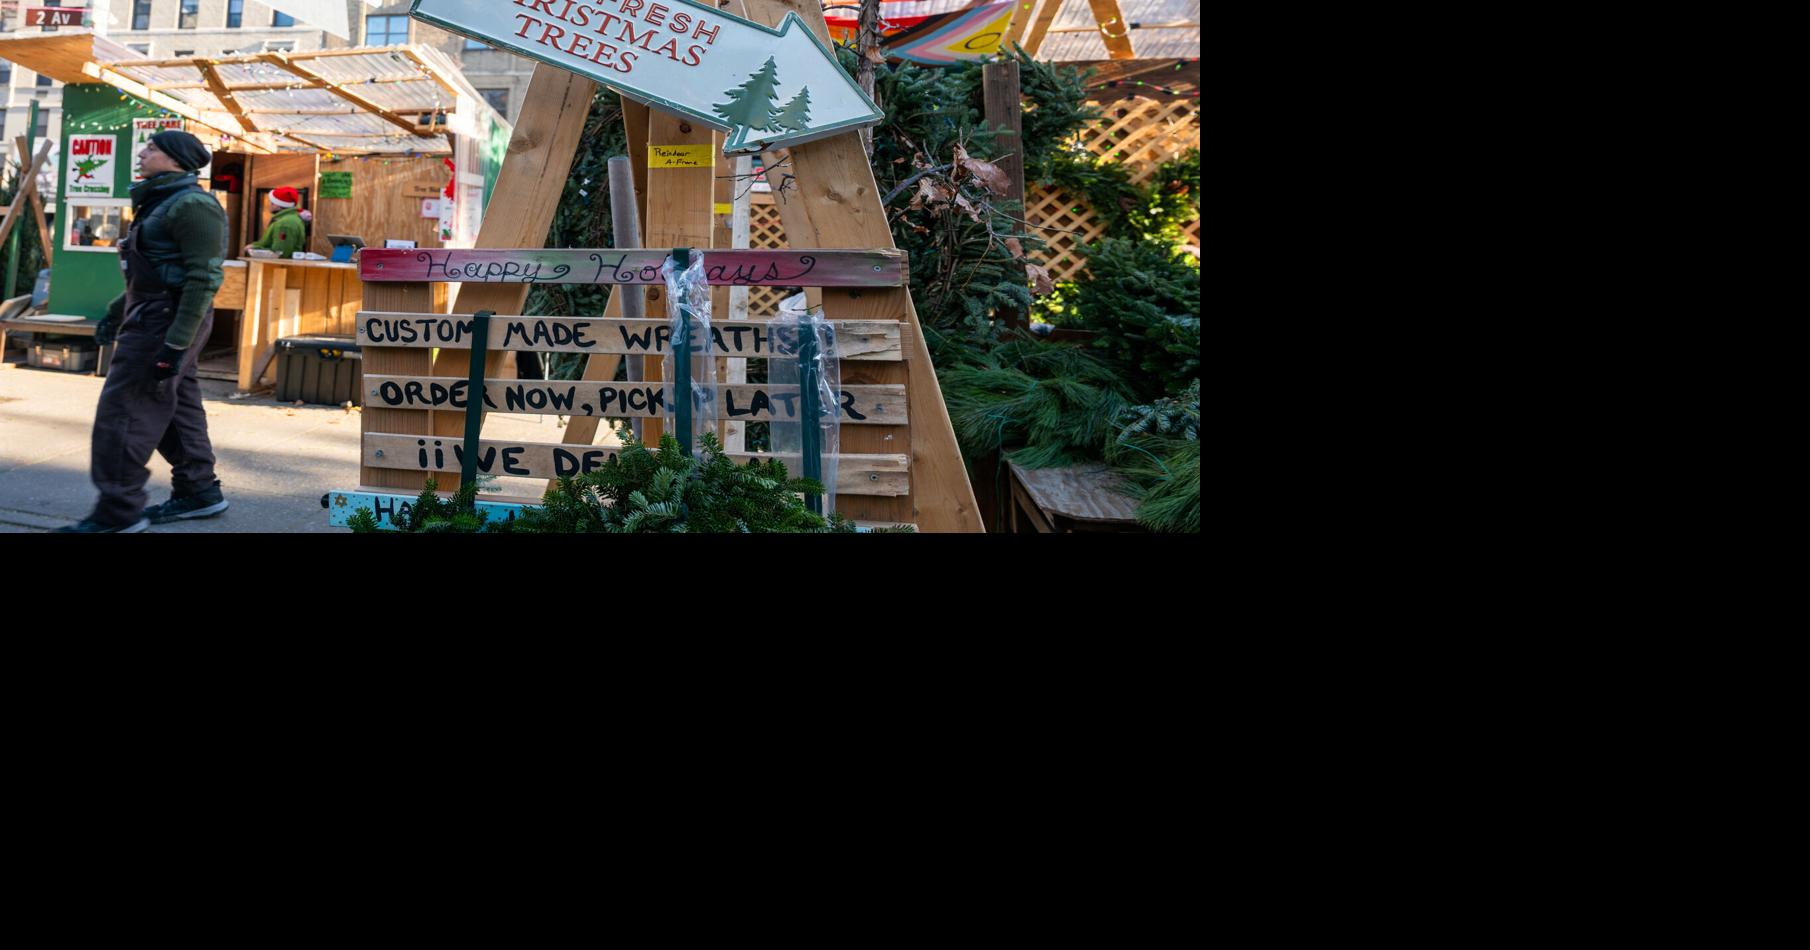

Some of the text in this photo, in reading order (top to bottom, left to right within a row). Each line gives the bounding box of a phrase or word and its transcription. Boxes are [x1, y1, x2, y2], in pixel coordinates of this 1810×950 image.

[36, 11, 71, 25] 2 Av
[596, 0, 721, 45] RESH
[514, 13, 639, 74] TREES
[72, 139, 113, 155] CAUTION
[416, 251, 570, 284] Happy
[366, 318, 475, 343] CUSTOM
[503, 319, 597, 347] MADE
[600, 387, 674, 415] PICK
[726, 388, 867, 421] LATR
